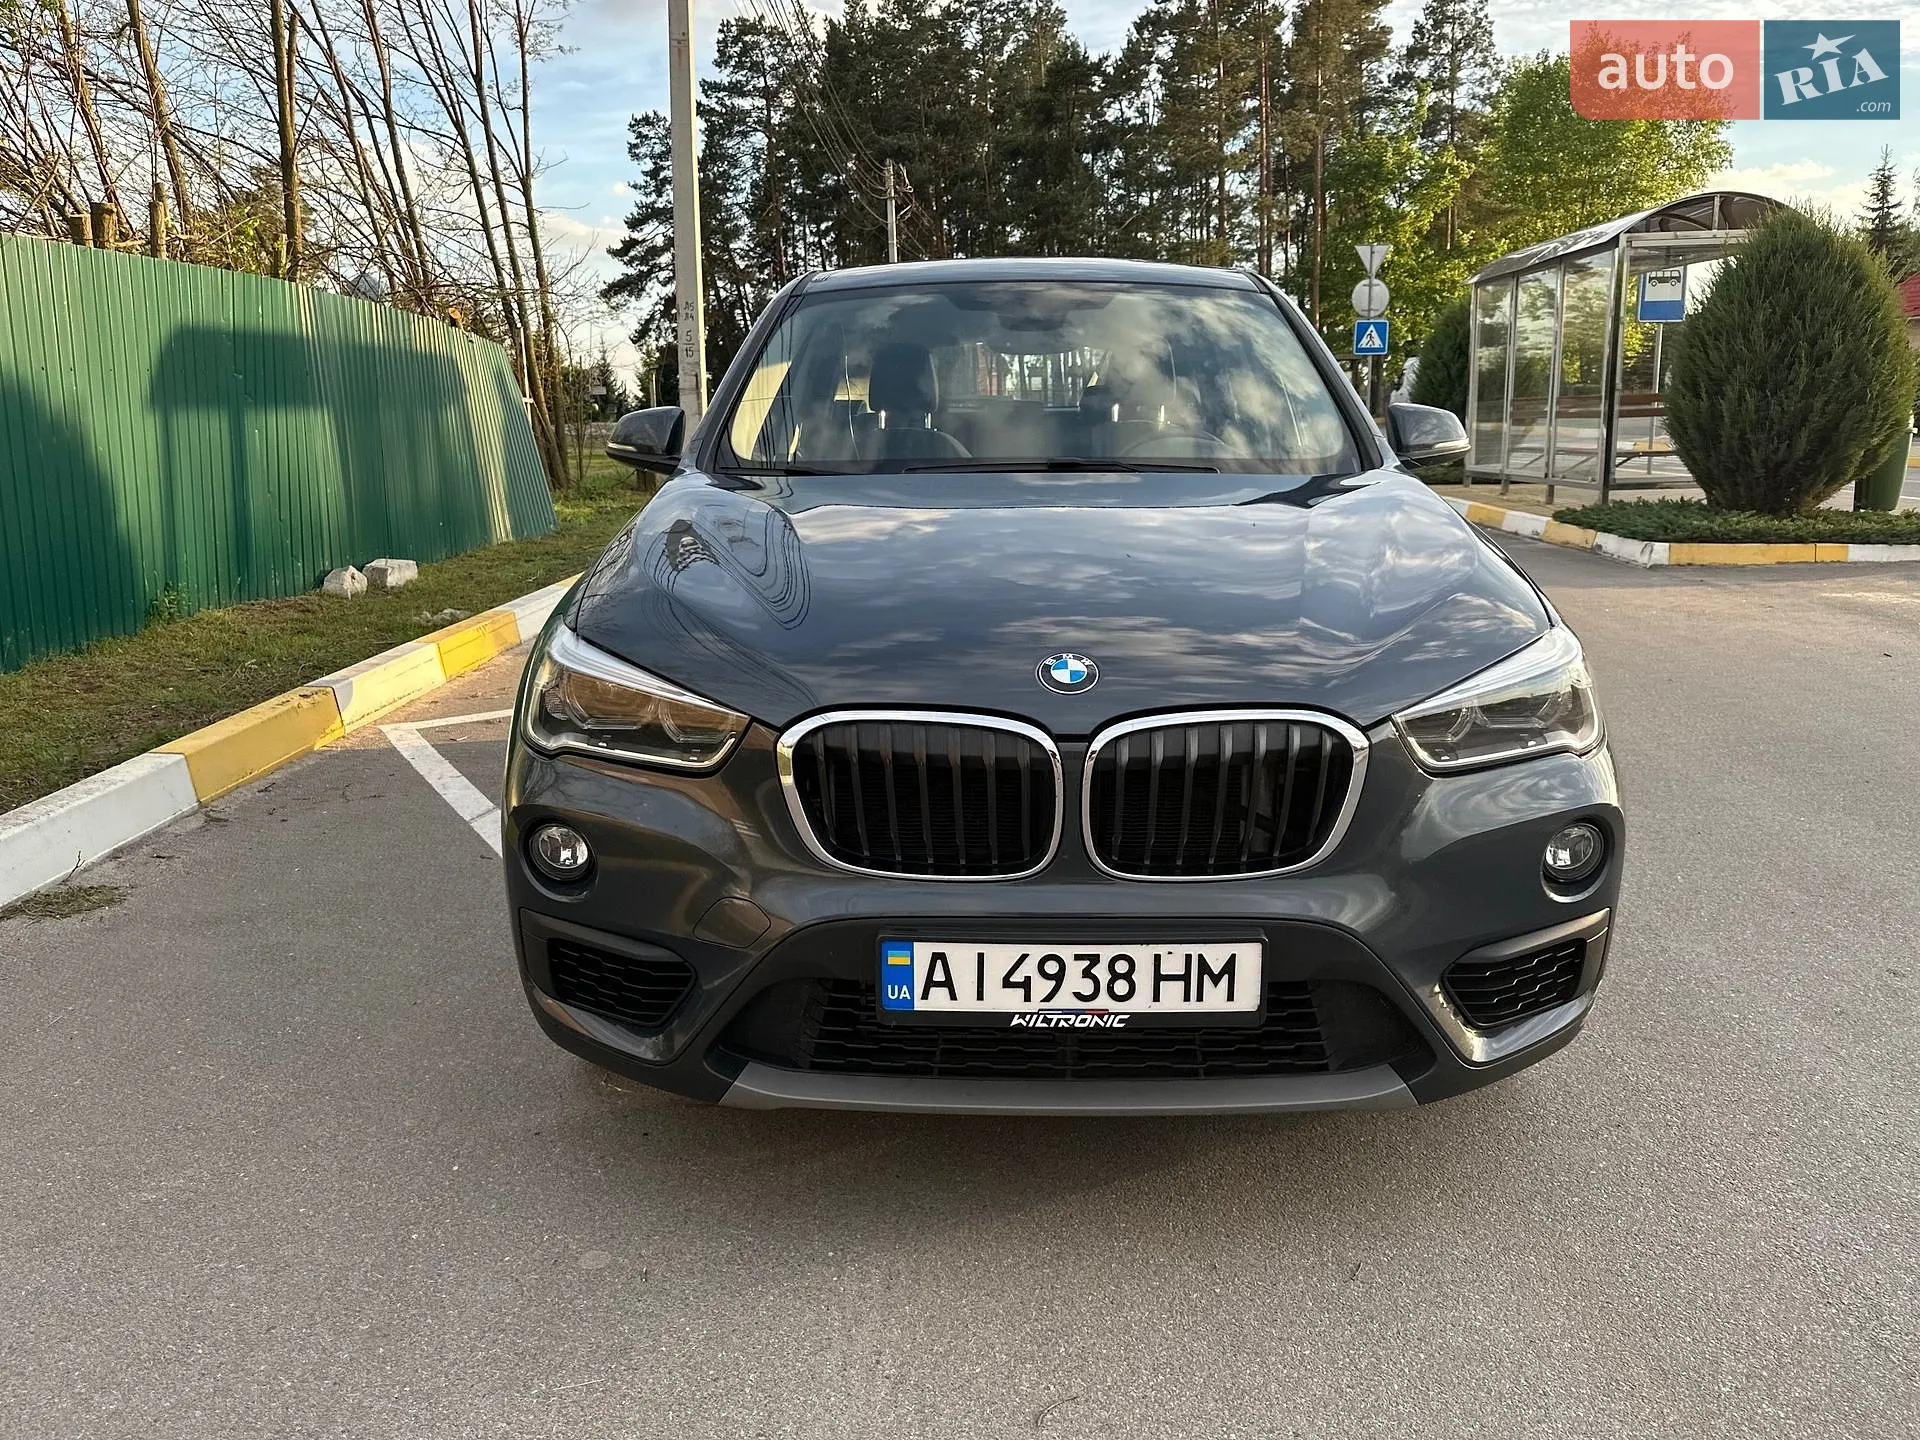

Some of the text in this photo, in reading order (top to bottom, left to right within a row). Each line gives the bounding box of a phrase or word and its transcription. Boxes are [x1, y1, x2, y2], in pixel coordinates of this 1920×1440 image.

[685, 329, 692, 342] 5
[685, 346, 694, 358] 15
[920, 951, 1237, 1003] AI 4938 HM
[887, 984, 911, 1000] UA
[1009, 1013, 1131, 1029] WILTRONIC
